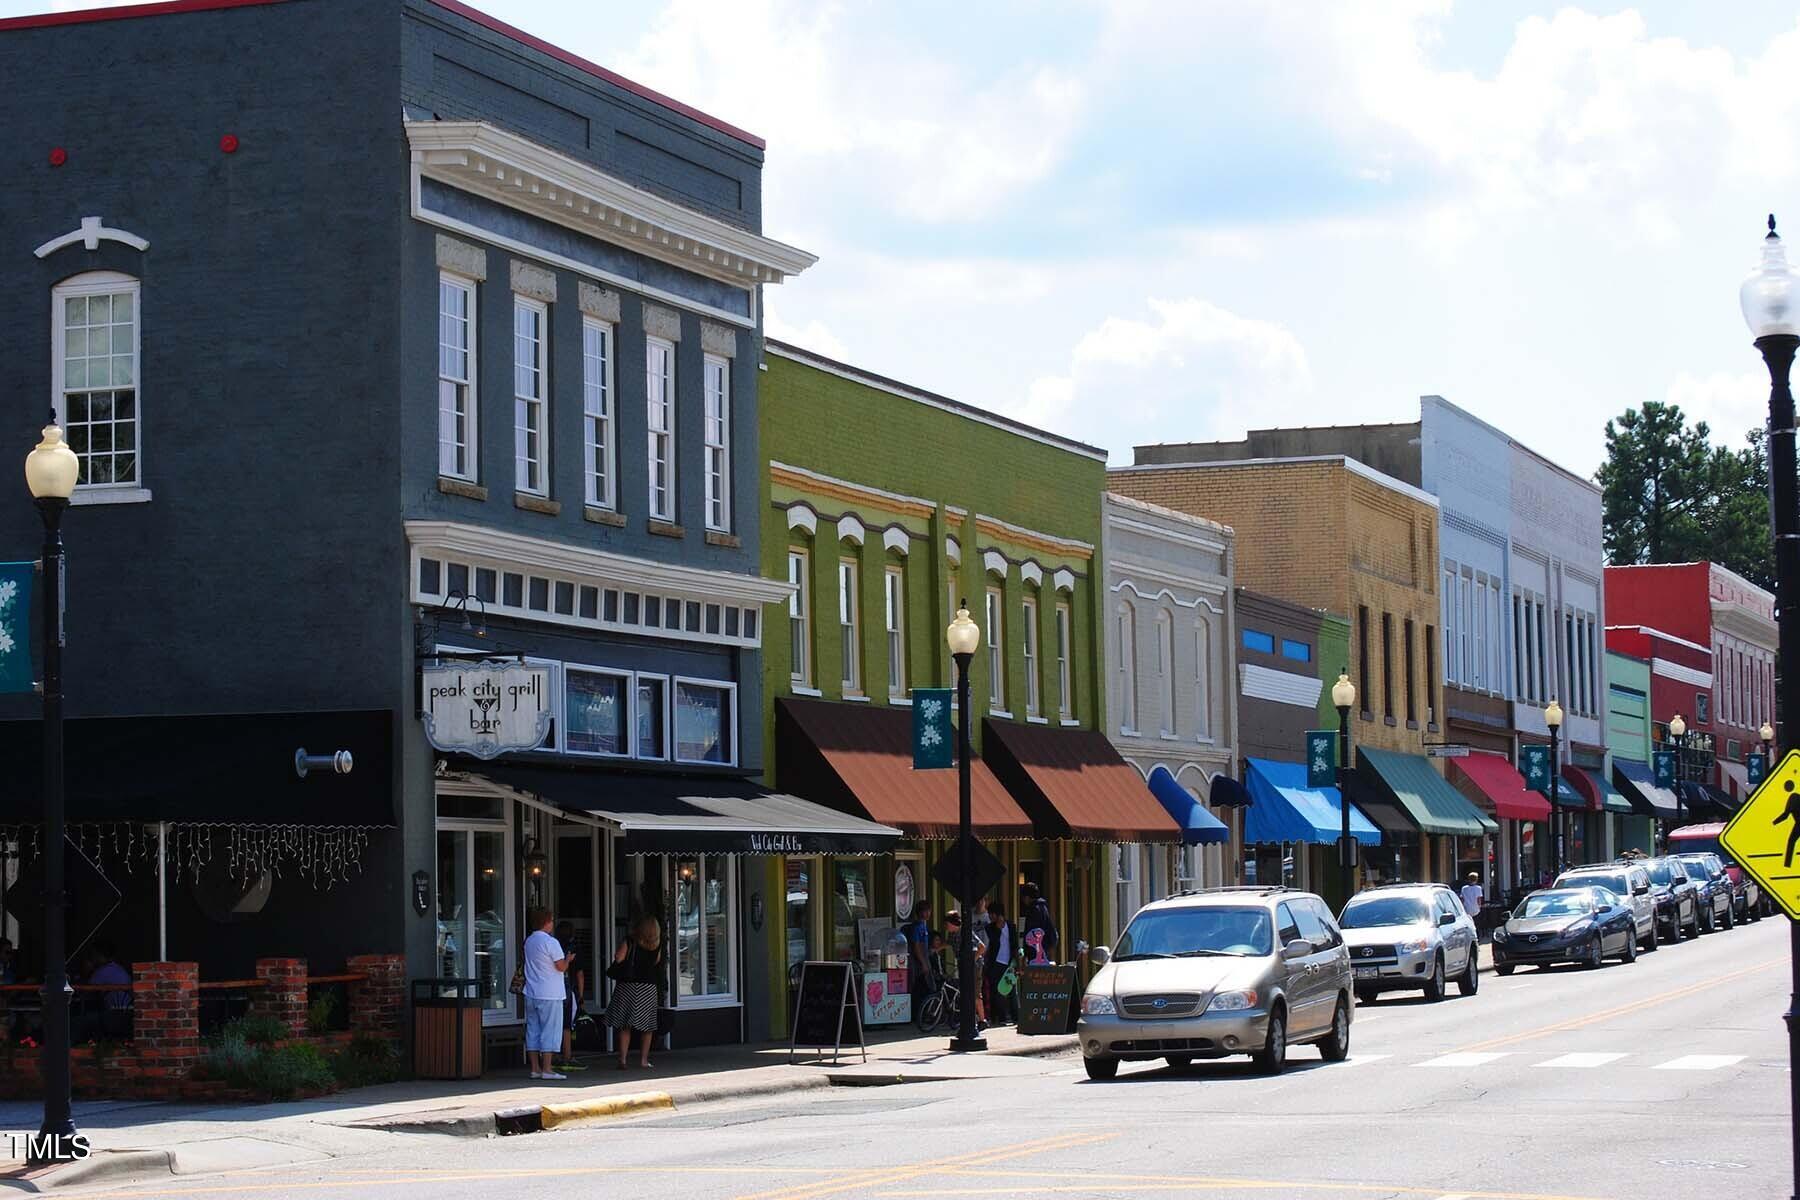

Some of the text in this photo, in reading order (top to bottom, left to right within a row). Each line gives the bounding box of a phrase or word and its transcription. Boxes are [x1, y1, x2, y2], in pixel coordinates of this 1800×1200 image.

[431, 674, 541, 712] peak city grill
[469, 709, 501, 730] bar
[1025, 992, 1069, 1000] ICE CREAM
